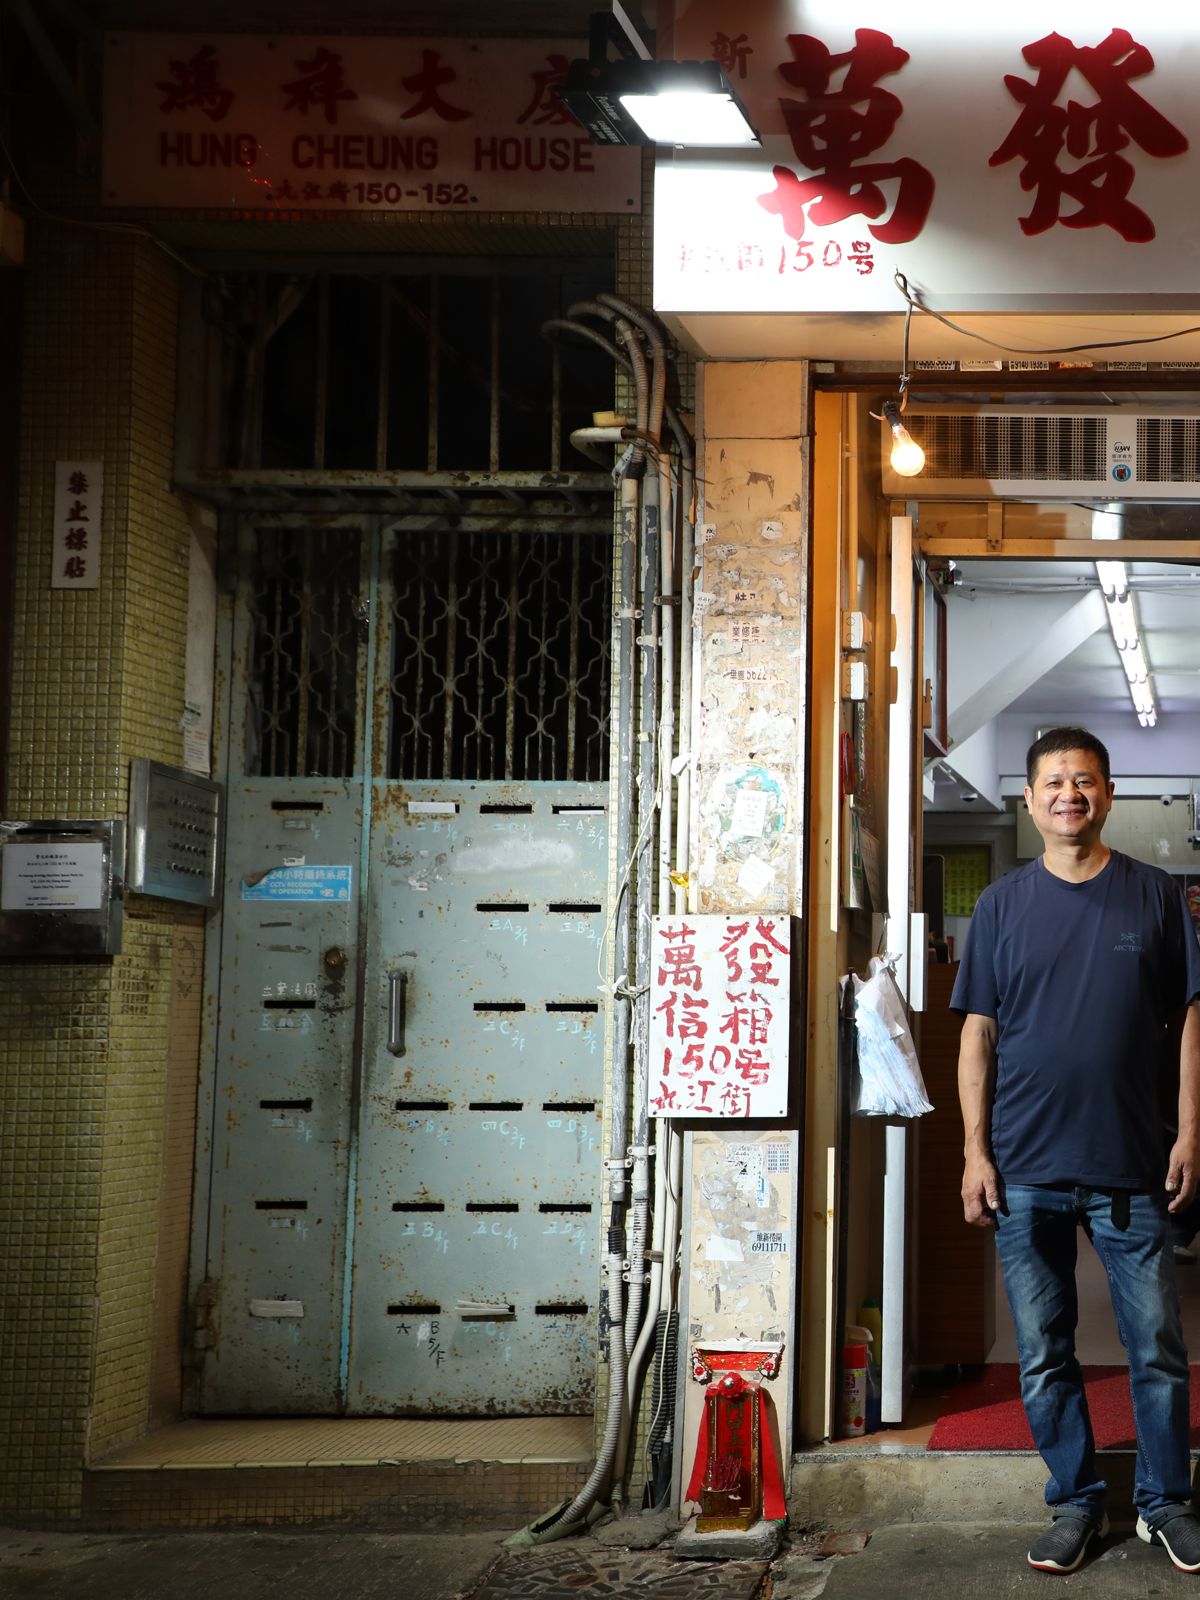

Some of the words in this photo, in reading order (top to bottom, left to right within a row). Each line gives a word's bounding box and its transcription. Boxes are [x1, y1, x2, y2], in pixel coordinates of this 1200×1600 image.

[712, 32, 754, 79] 新
[161, 133, 257, 168] HUNG
[292, 135, 438, 171] CHEUNG
[475, 137, 595, 172] HOUSE
[658, 916, 791, 991] 萬發
[656, 988, 773, 1045] 信箱
[752, 1242, 787, 1252] 69111711
